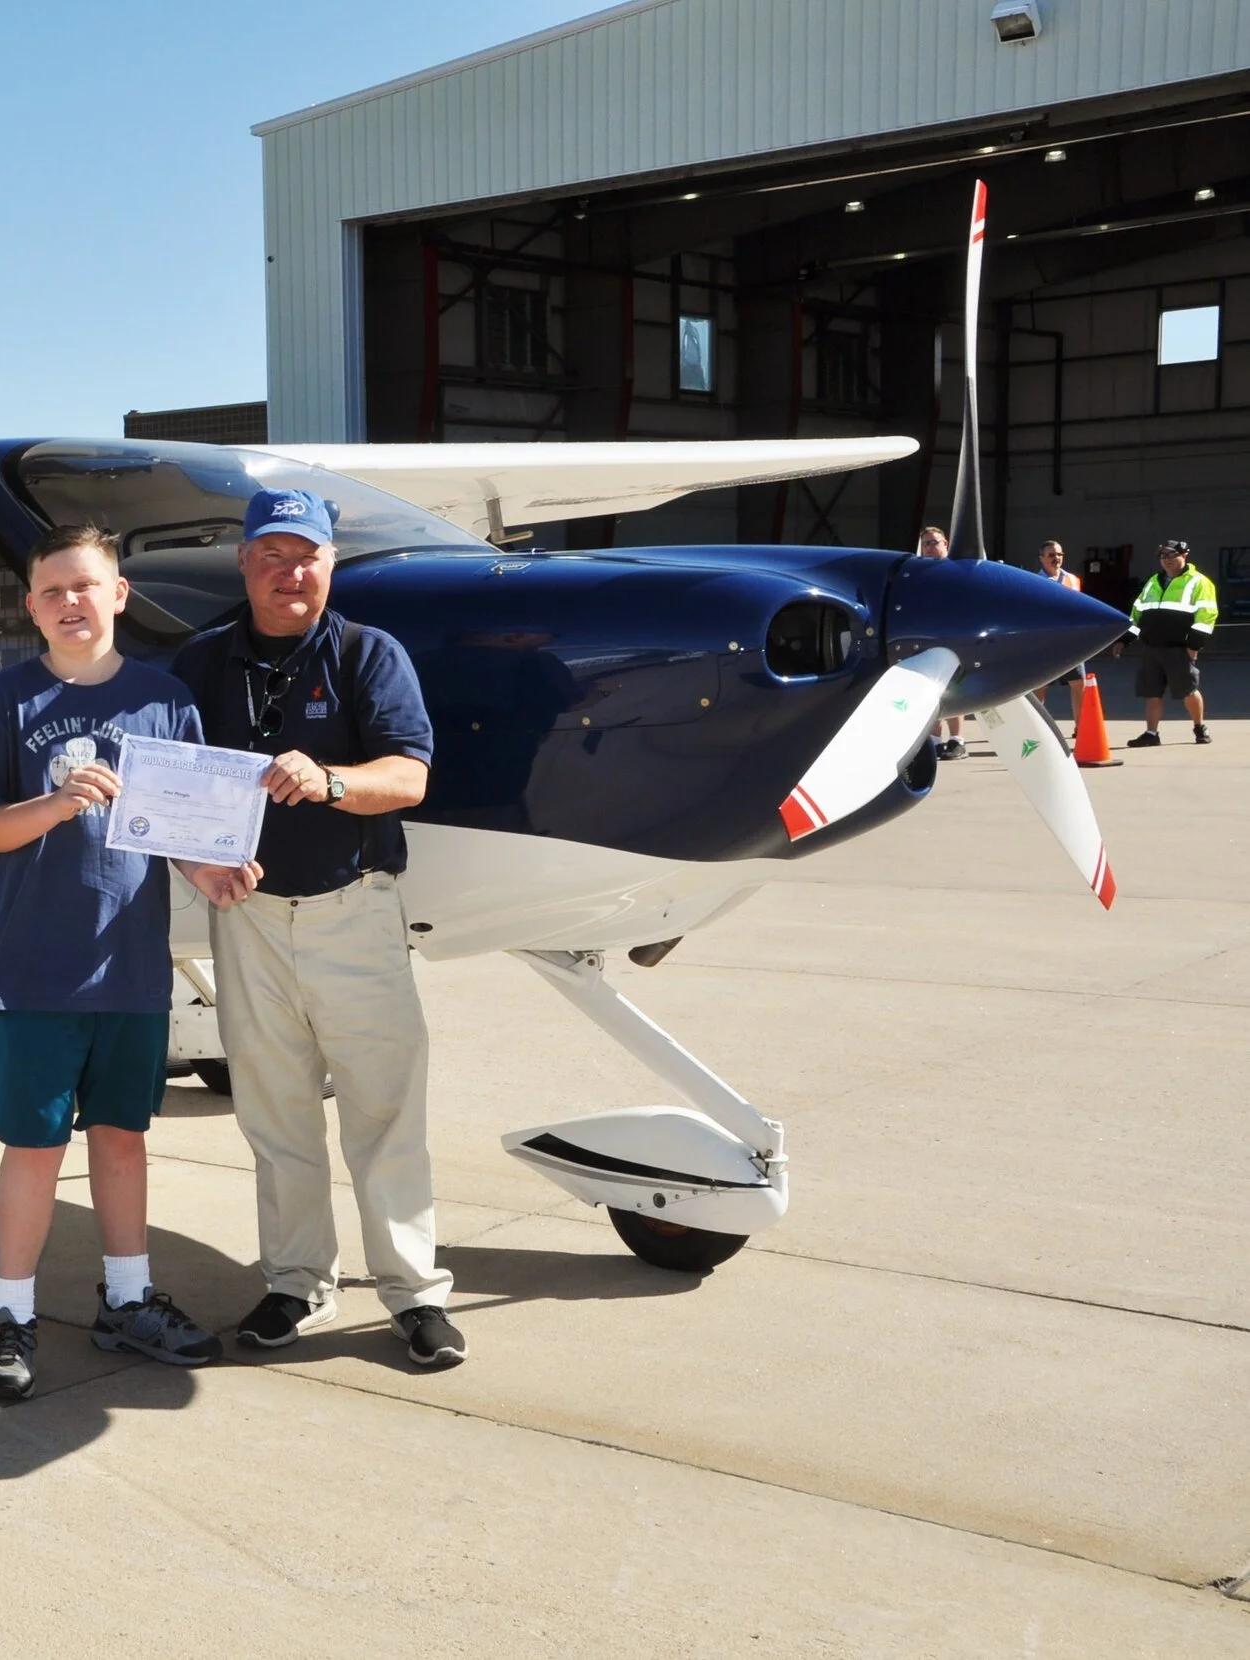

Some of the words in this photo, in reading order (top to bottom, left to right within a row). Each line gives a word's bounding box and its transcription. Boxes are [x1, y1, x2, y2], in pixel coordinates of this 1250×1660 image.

[25, 717, 86, 753] FEELIN'
[91, 718, 124, 745] LUC
[141, 755, 170, 767] YOUNG
[171, 759, 201, 772] EAGLES
[202, 764, 251, 780] CERTIFICATE
